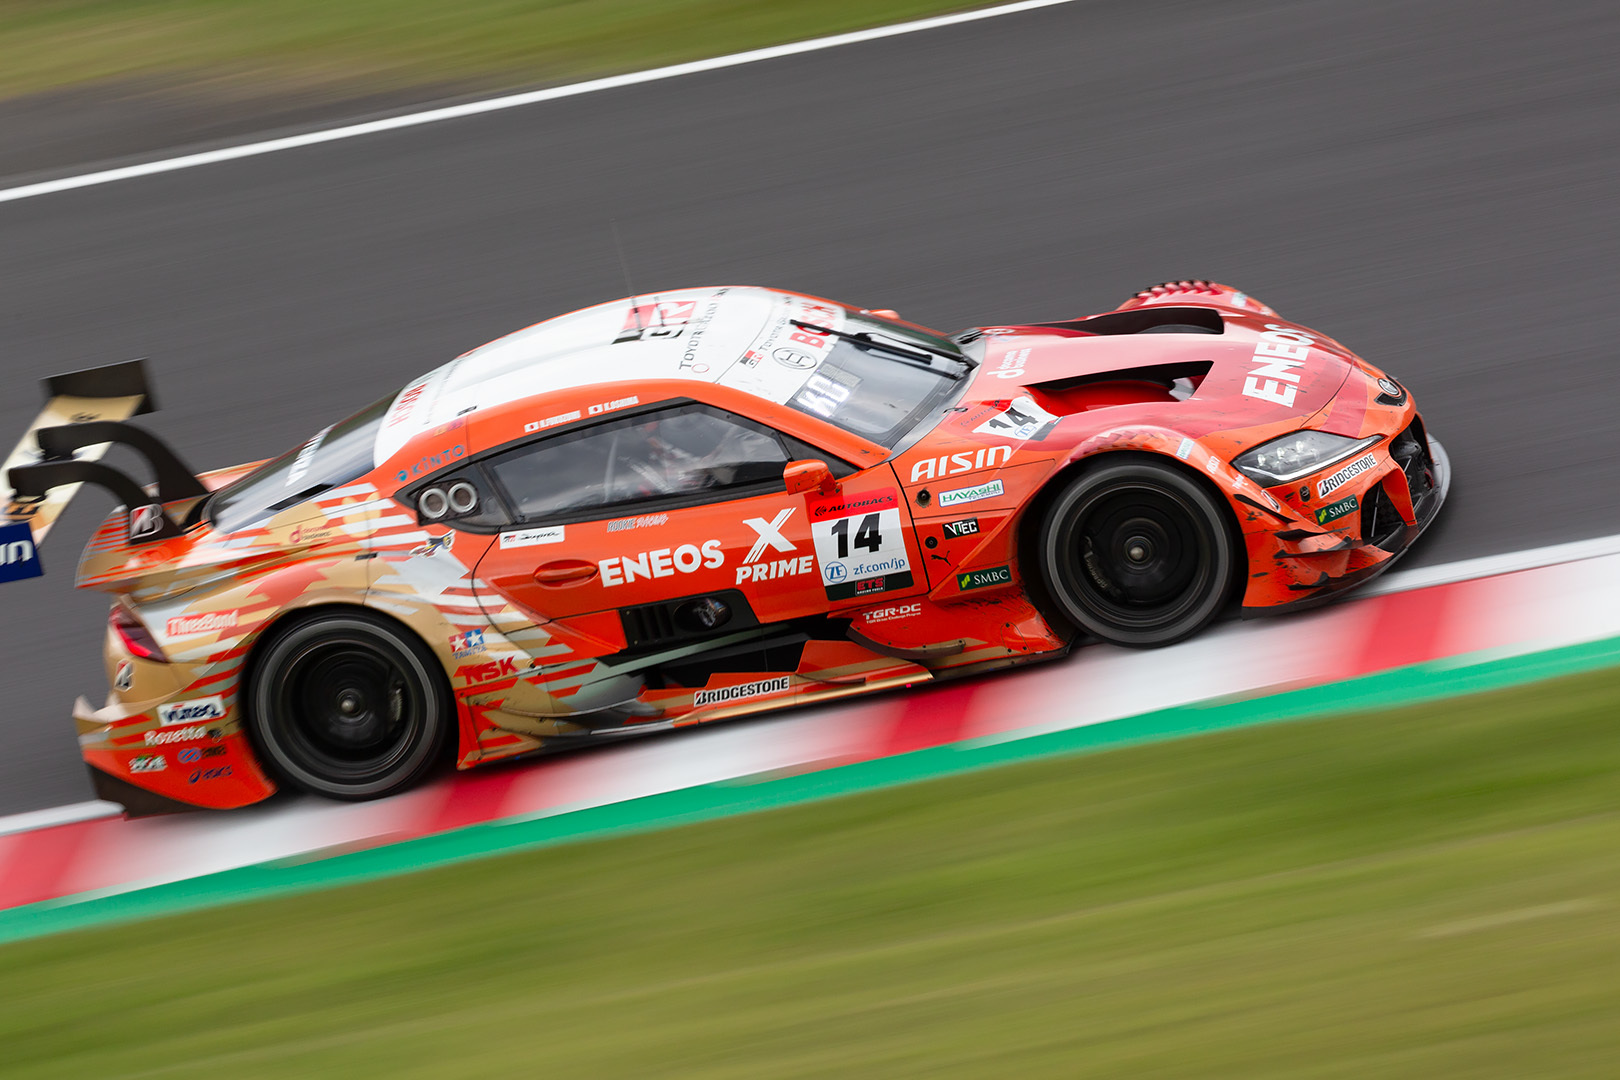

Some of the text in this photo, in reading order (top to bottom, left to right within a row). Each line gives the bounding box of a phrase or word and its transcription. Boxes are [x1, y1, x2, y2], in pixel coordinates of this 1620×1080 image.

[1242, 324, 1317, 408] ENEOS
[988, 407, 1039, 430] 14
[911, 445, 1012, 482] AISIN
[1318, 453, 1377, 497] BRIDGESTONE
[828, 495, 893, 512] AUTOBACS
[942, 483, 1001, 502] HAYASHI
[1329, 498, 1358, 518] SMBC
[607, 518, 636, 533] ROOKIE
[743, 507, 797, 564] X
[831, 513, 882, 558] 14
[598, 540, 724, 587] ENEOS
[736, 555, 813, 585] PRIME
[853, 557, 906, 575] zf.com/jp
[974, 569, 1009, 585] SMBC
[857, 577, 884, 591] ETS
[168, 609, 238, 634] ThreeBond
[463, 656, 519, 685] NSK
[694, 677, 789, 707] BRIDGESTONE
